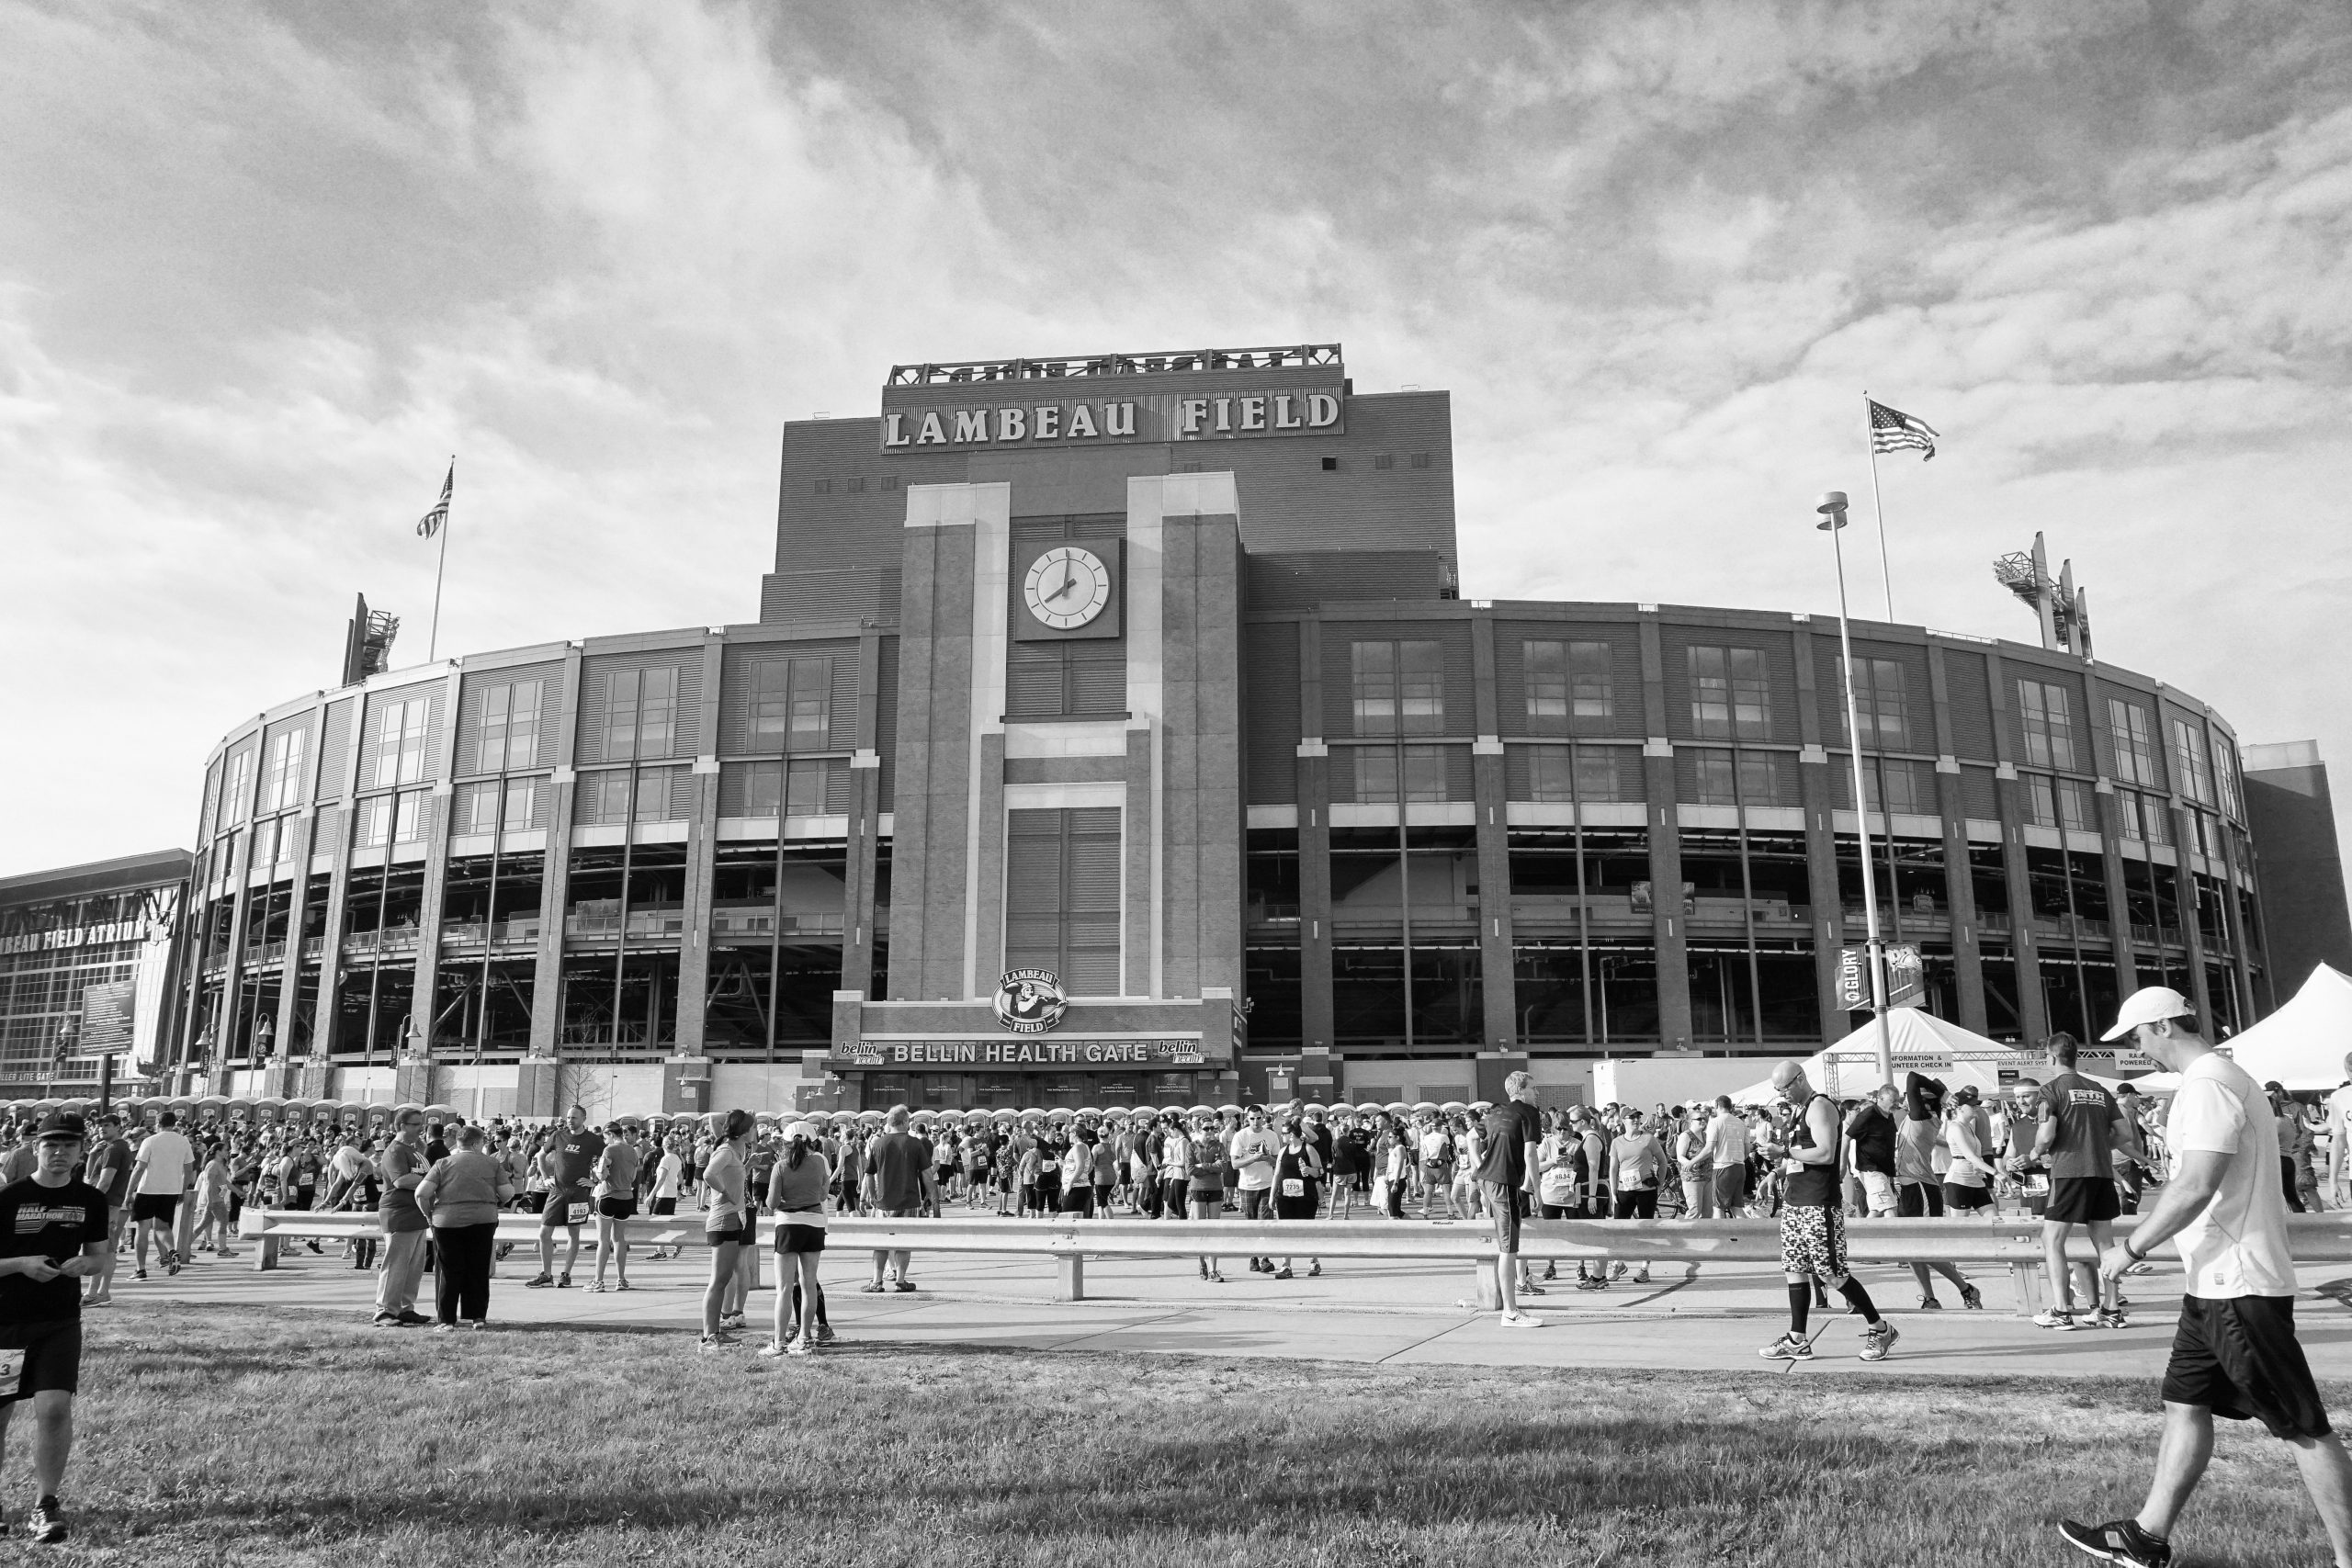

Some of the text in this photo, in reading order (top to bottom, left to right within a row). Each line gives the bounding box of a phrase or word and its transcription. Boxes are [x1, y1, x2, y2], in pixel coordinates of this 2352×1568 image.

[886, 394, 1339, 446] LAMBEAU FIELD
[43, 928, 84, 950] FIELD
[87, 919, 145, 945] ATRIUM
[1005, 970, 1054, 983] LAMBEAU
[1013, 1022, 1044, 1032] FIELD
[841, 1043, 877, 1055] bellin
[894, 1043, 1148, 1062] BELLIN HEALTH GATE
[1159, 1041, 1196, 1054] bellin
[36, 1072, 54, 1081] GATE
[18, 1205, 47, 1213] HALF
[16, 1213, 64, 1221] MARATHON
